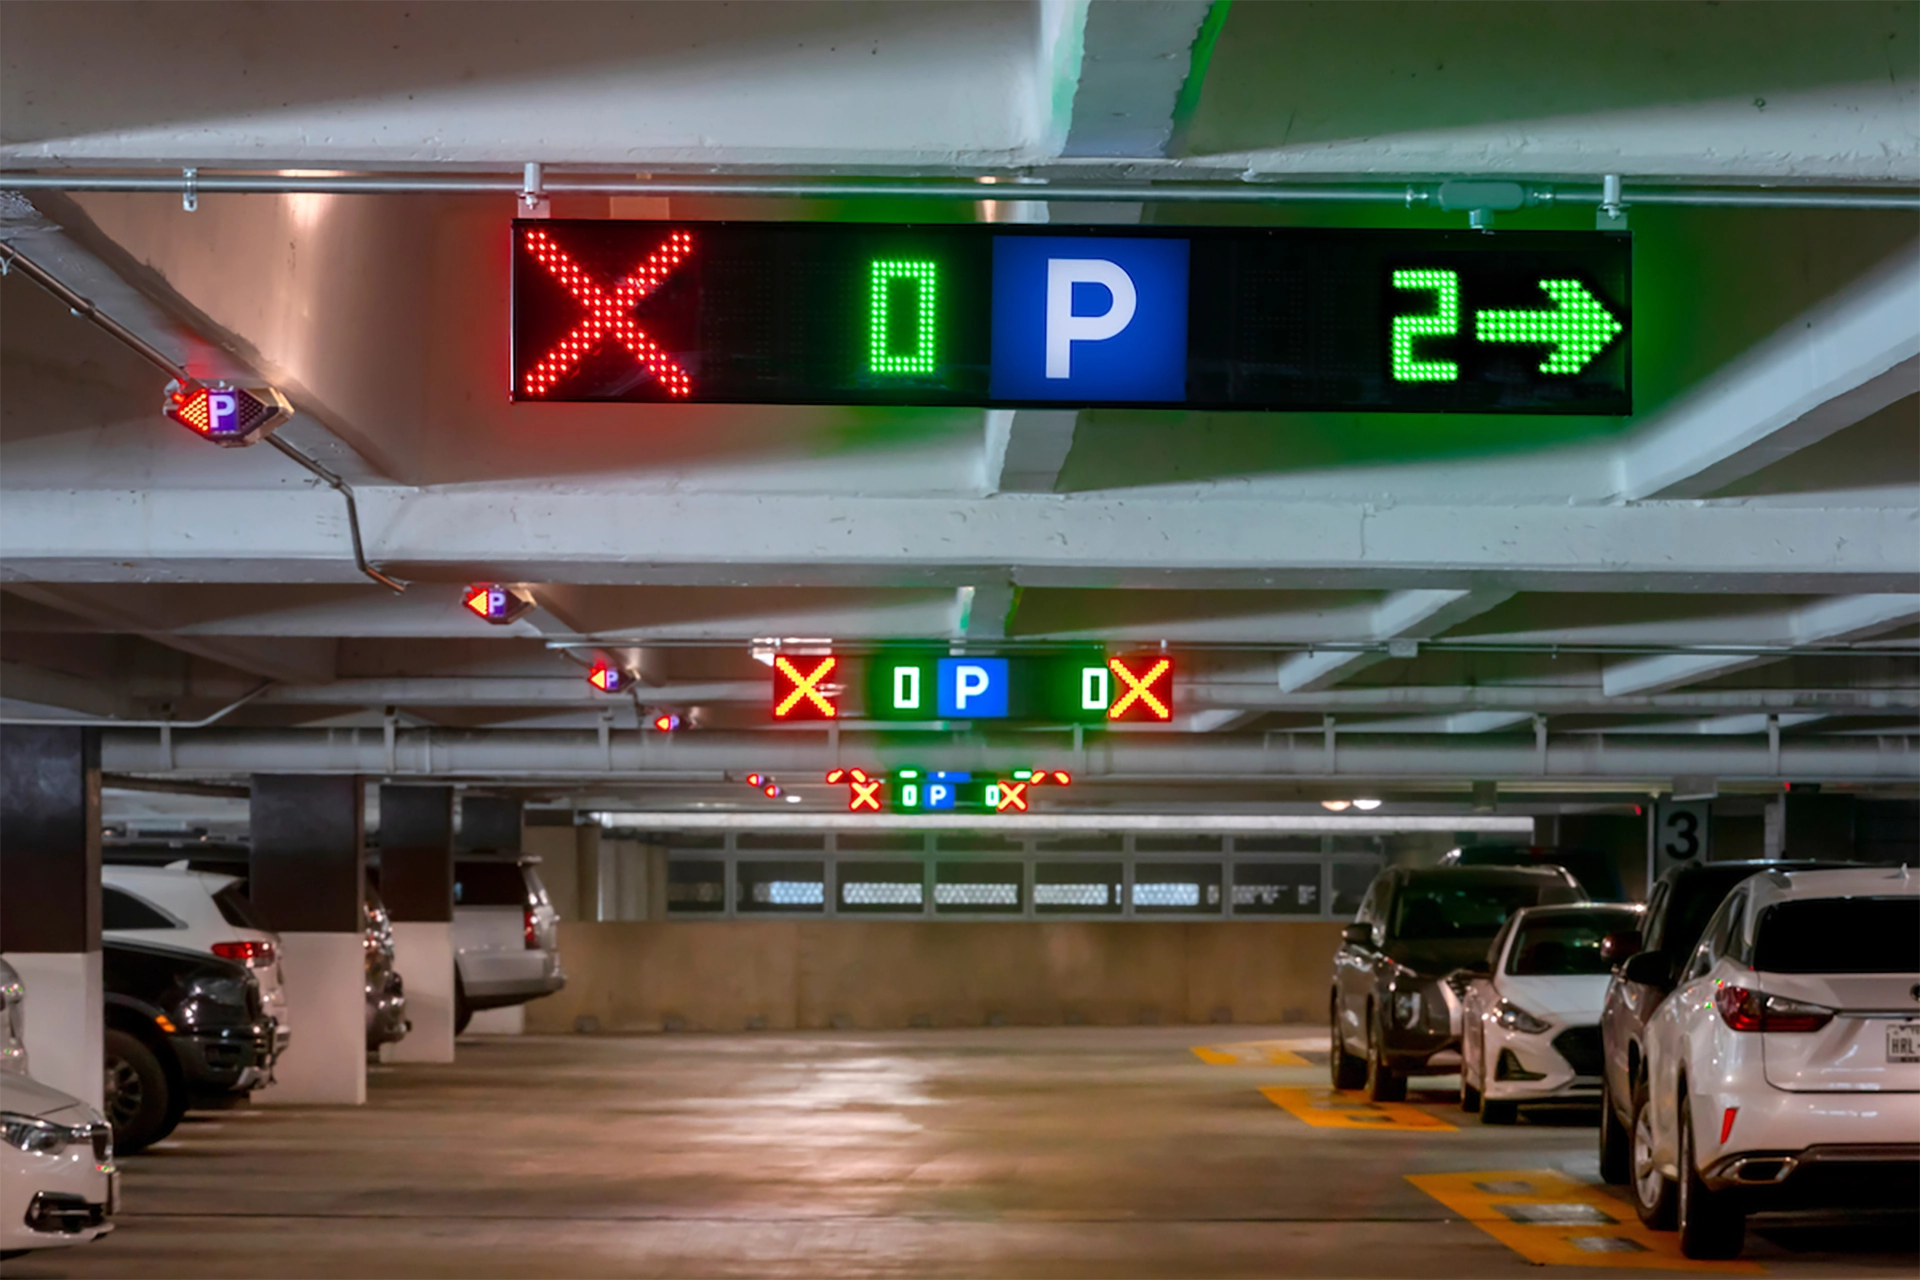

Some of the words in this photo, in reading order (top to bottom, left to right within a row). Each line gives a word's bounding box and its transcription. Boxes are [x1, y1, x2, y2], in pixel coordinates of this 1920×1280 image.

[1045, 258, 1137, 379] P
[1392, 268, 1460, 383] 2
[208, 394, 236, 429] P
[488, 592, 506, 614] P
[606, 670, 619, 689] P
[955, 665, 989, 710] P
[930, 784, 947, 806] P
[1665, 809, 1699, 860] 3
